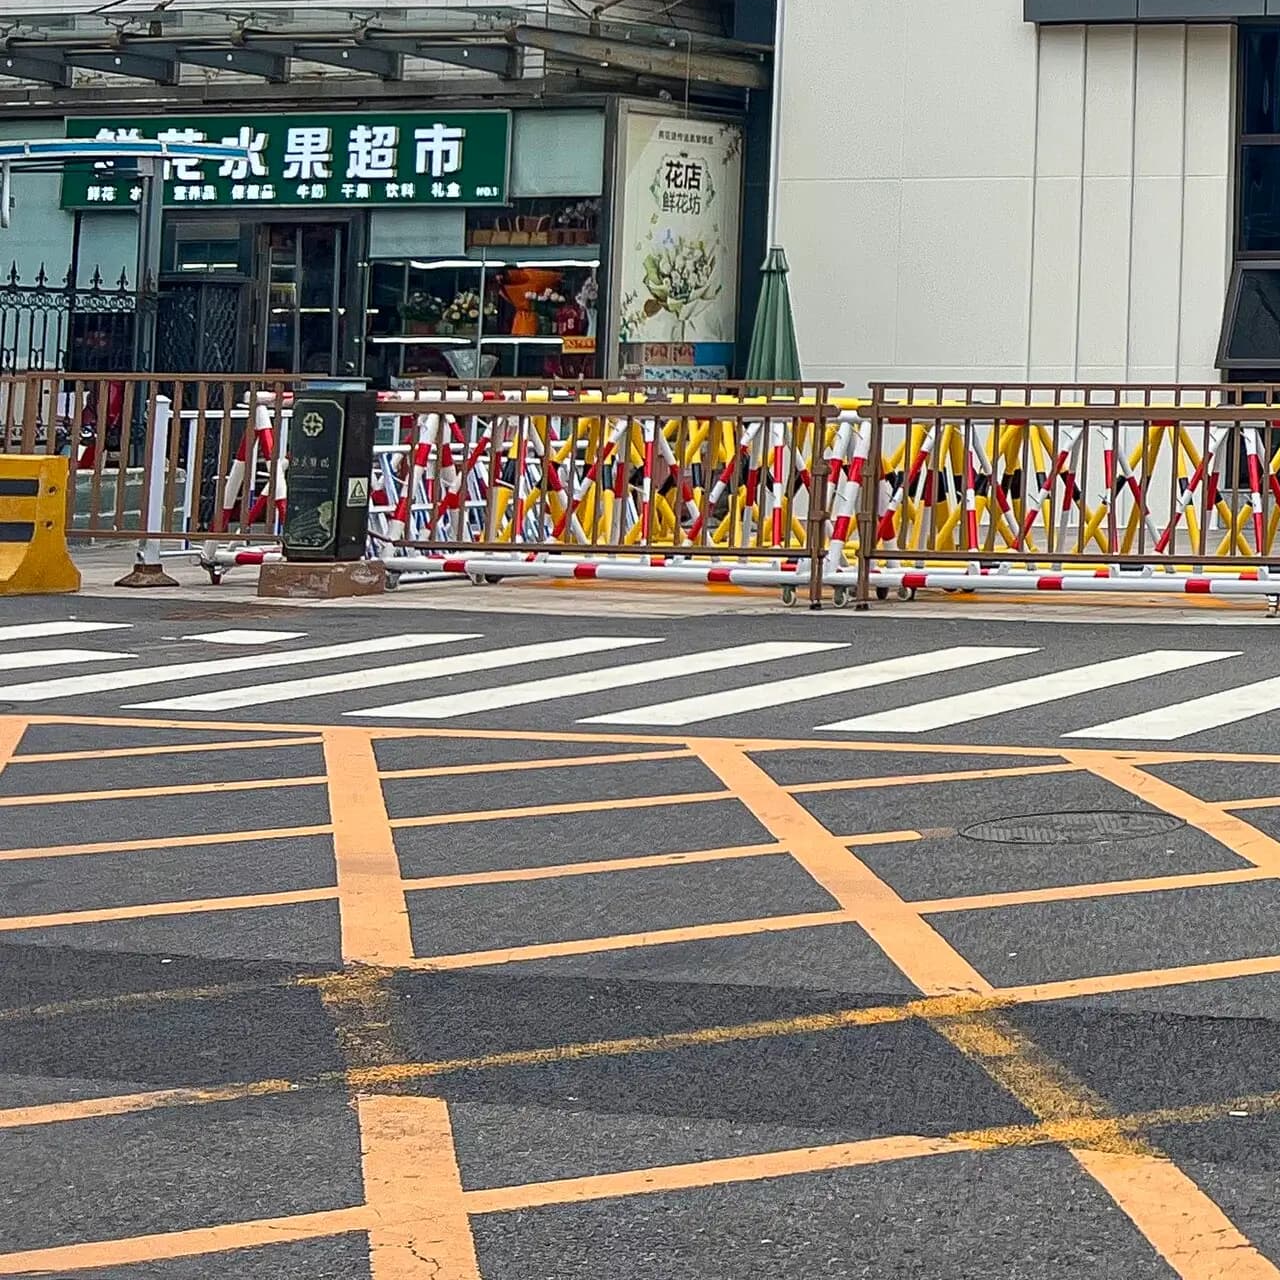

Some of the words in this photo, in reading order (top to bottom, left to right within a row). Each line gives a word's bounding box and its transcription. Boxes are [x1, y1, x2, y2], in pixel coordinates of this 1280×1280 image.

[95, 123, 468, 182] 花水果超市
[665, 160, 702, 191] 花店
[296, 183, 327, 200] 牛奶
[386, 182, 416, 199] 饮料
[431, 182, 463, 199] 礼盒
[662, 191, 702, 215] 鲜花坊
